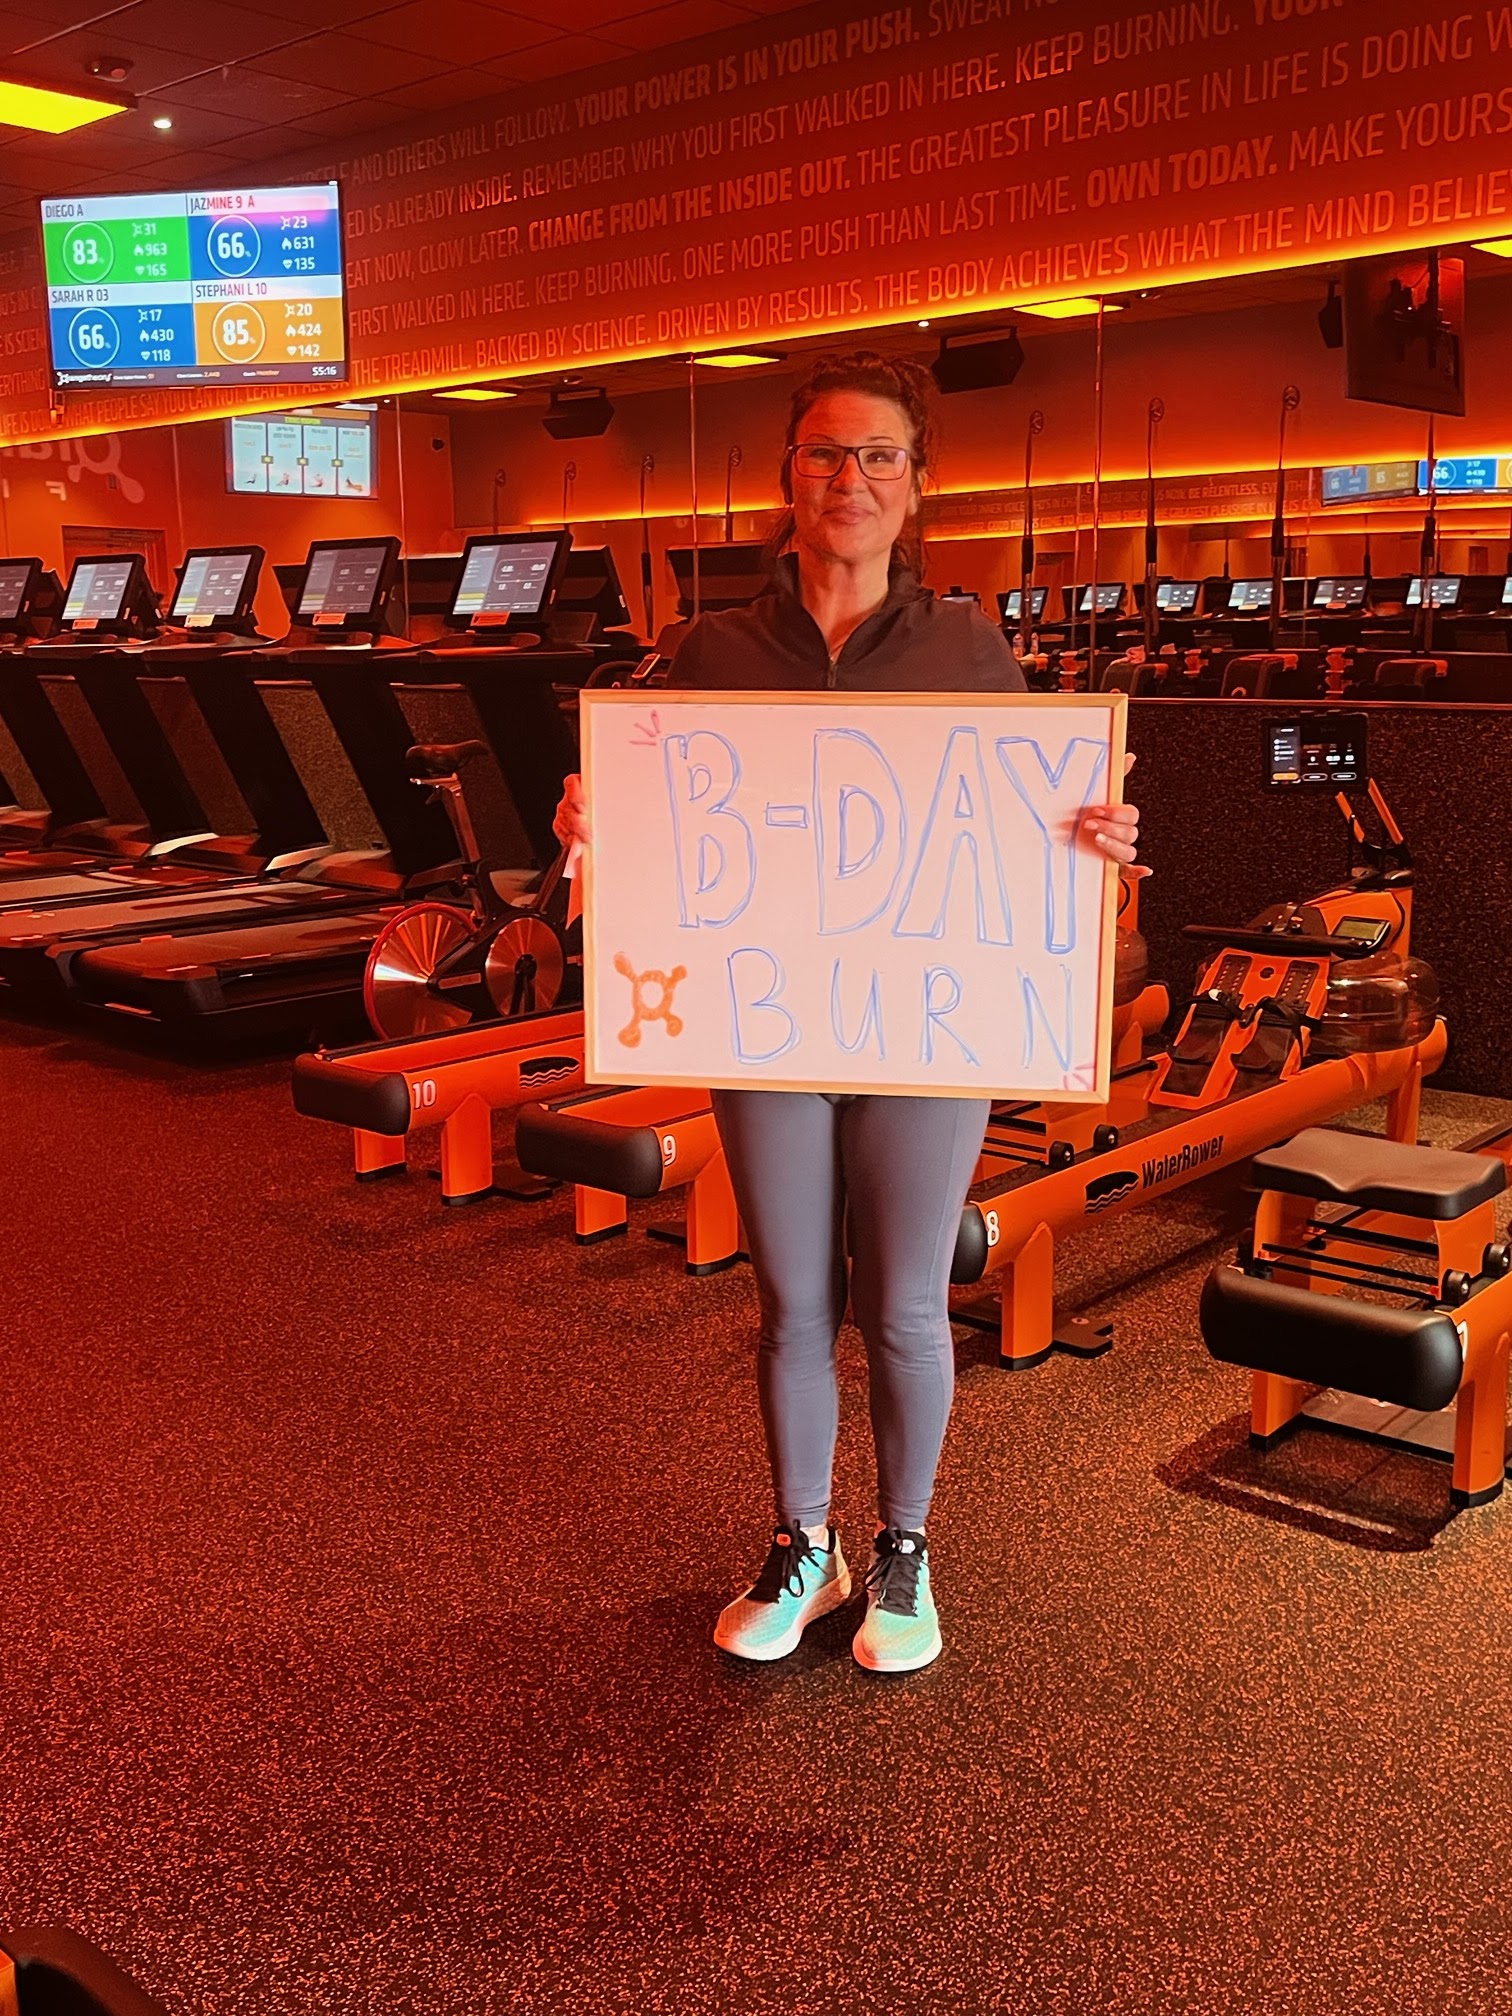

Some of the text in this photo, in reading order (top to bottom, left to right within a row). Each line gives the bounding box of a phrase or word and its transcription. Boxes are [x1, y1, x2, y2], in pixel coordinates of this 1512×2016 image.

[353, 153, 383, 185] AND
[387, 137, 447, 177] OTHERS
[450, 129, 490, 161] WILL
[495, 103, 570, 149] FOLLOW.
[575, 86, 629, 129] YOUR
[634, 64, 711, 114] POWER
[717, 55, 738, 93] IS
[744, 46, 769, 85] IN
[773, 29, 838, 76] YOUR
[845, 7, 920, 58] PUSH.
[369, 205, 383, 233] IS
[387, 186, 454, 231] ALREADY
[459, 173, 517, 213] INSIDE.
[523, 146, 626, 199] REMEMBER
[631, 132, 676, 173] WHY
[682, 121, 723, 161] YOU
[730, 105, 789, 150] FIRST
[795, 81, 890, 135] WALKED
[899, 71, 923, 111] IN
[932, 53, 1006, 104] HERE.
[1015, 31, 1084, 84] KEEP
[1093, 1, 1239, 66] BURNING.
[375, 248, 414, 286] NOW,
[419, 238, 467, 275] GLOW
[470, 225, 523, 266] LATER.
[528, 208, 603, 251] CHANGE
[610, 197, 667, 237] FROM
[672, 185, 712, 223] THE
[718, 167, 792, 214] INSIDE
[800, 155, 850, 198] OUT.
[857, 144, 901, 185] THE
[909, 113, 1035, 176] GREATEST
[1044, 78, 1190, 148] PLEASURE
[1201, 68, 1232, 113] IN
[1244, 51, 1309, 104] LIFE
[1321, 42, 1349, 88] IS
[1362, 15, 1473, 79] DOING
[45, 204, 84, 218] DIEGO A
[190, 195, 255, 214] JAZMINE 9 A
[144, 222, 157, 236] 31
[292, 216, 308, 229] 23
[350, 304, 388, 338] FIRST
[392, 294, 453, 332] WALKED
[461, 289, 483, 319] IN
[484, 279, 529, 315] HERE.
[536, 270, 578, 306] KEEP
[586, 253, 676, 296] BURNING.
[684, 242, 724, 279] ONE
[731, 229, 792, 272] MORE
[801, 215, 859, 260] PUSH
[866, 203, 930, 248] THAN
[940, 190, 999, 235] LAST
[1006, 175, 1076, 223] TIME.
[1087, 158, 1160, 208] OWN
[1168, 135, 1277, 192] TODAY.
[1289, 112, 1385, 172] MAKE
[145, 242, 167, 256] 963
[293, 236, 315, 250] 631
[146, 263, 167, 277] 165
[294, 257, 315, 270] 135
[195, 282, 267, 298] STEPHANI L 10
[352, 358, 378, 384] THE
[383, 342, 471, 380] TREADMILL.
[476, 333, 538, 368] BACKED
[545, 325, 569, 359] BY
[573, 313, 650, 354] SCIENCE.
[658, 301, 729, 340] DRIVEN
[737, 295, 763, 330] BY
[769, 279, 867, 325] RESULTS.
[875, 270, 919, 308] THE
[927, 258, 993, 302] BODY
[1000, 234, 1129, 291] ACHIEVES
[1137, 218, 1226, 269] WHAT
[1235, 206, 1294, 253] THE
[1305, 190, 1394, 243] MIND
[52, 289, 84, 303] SARAH
[87, 289, 94, 302] R
[96, 289, 109, 301] 03
[149, 309, 162, 322] 17
[297, 303, 313, 316] 20
[150, 329, 174, 342] 430
[297, 323, 322, 336] 424
[152, 348, 171, 362] 118
[298, 344, 320, 357] 142
[97, 395, 138, 423] PEOPLE
[140, 392, 160, 417] SAY
[160, 389, 186, 414] YOU
[189, 387, 213, 411] CAN
[662, 726, 1107, 953] B-DAY
[727, 947, 1073, 1071] BURN
[412, 1080, 436, 1109] 10
[662, 1135, 677, 1167] 9
[1142, 1135, 1224, 1189] WaterRower
[986, 1209, 1000, 1247] 8
[1456, 1320, 1468, 1363] 7
